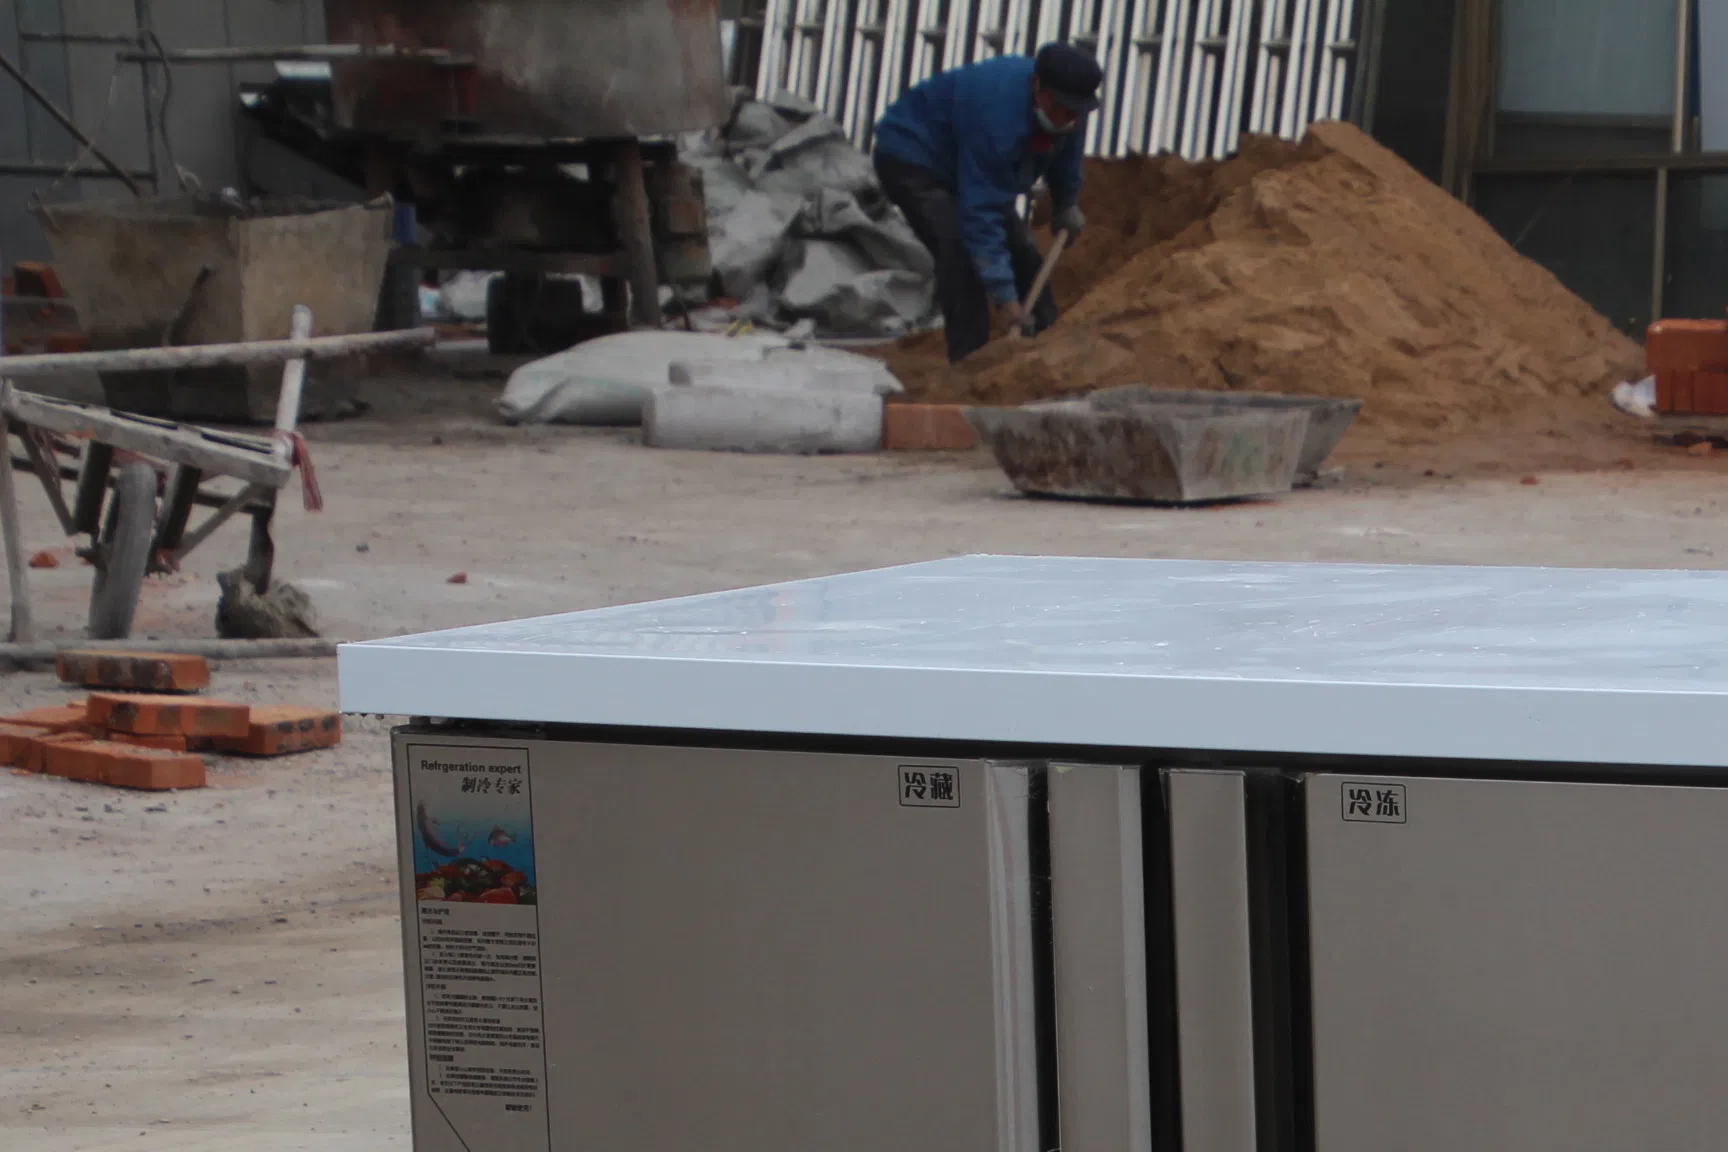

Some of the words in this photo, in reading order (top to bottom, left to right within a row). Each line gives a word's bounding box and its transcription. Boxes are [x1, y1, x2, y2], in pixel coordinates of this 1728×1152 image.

[489, 764, 522, 775] expert
[461, 777, 522, 795] 制冷专家
[904, 772, 954, 801] 冷藏
[1349, 789, 1400, 817] 冷冻
